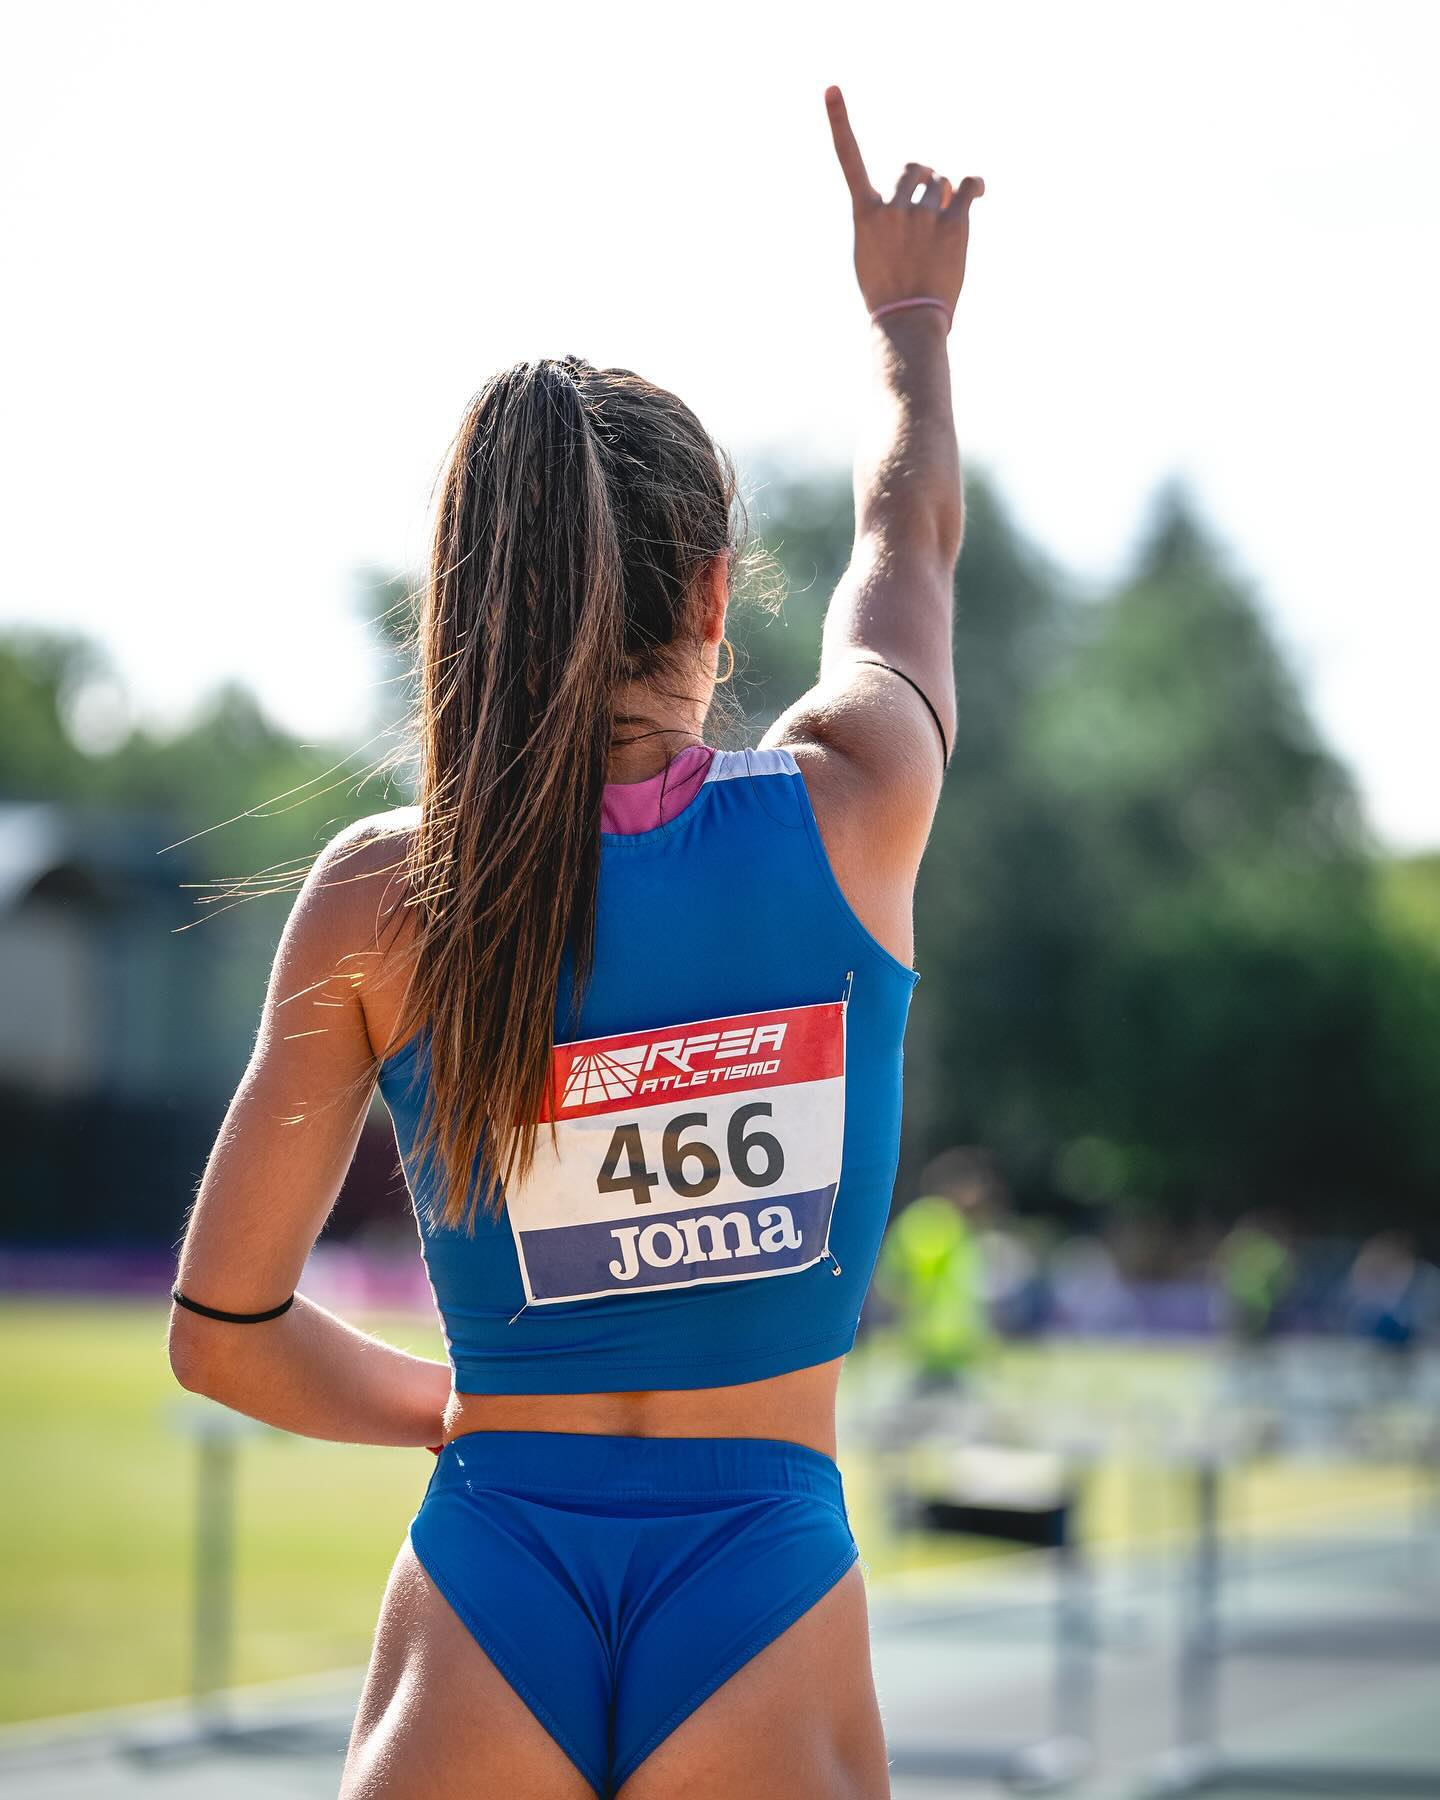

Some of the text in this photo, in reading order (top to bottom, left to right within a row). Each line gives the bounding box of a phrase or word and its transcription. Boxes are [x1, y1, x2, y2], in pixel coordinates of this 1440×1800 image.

[644, 1023, 788, 1072] RFEA
[639, 1059, 781, 1095] ATLETISMO
[596, 1102, 785, 1205] 466
